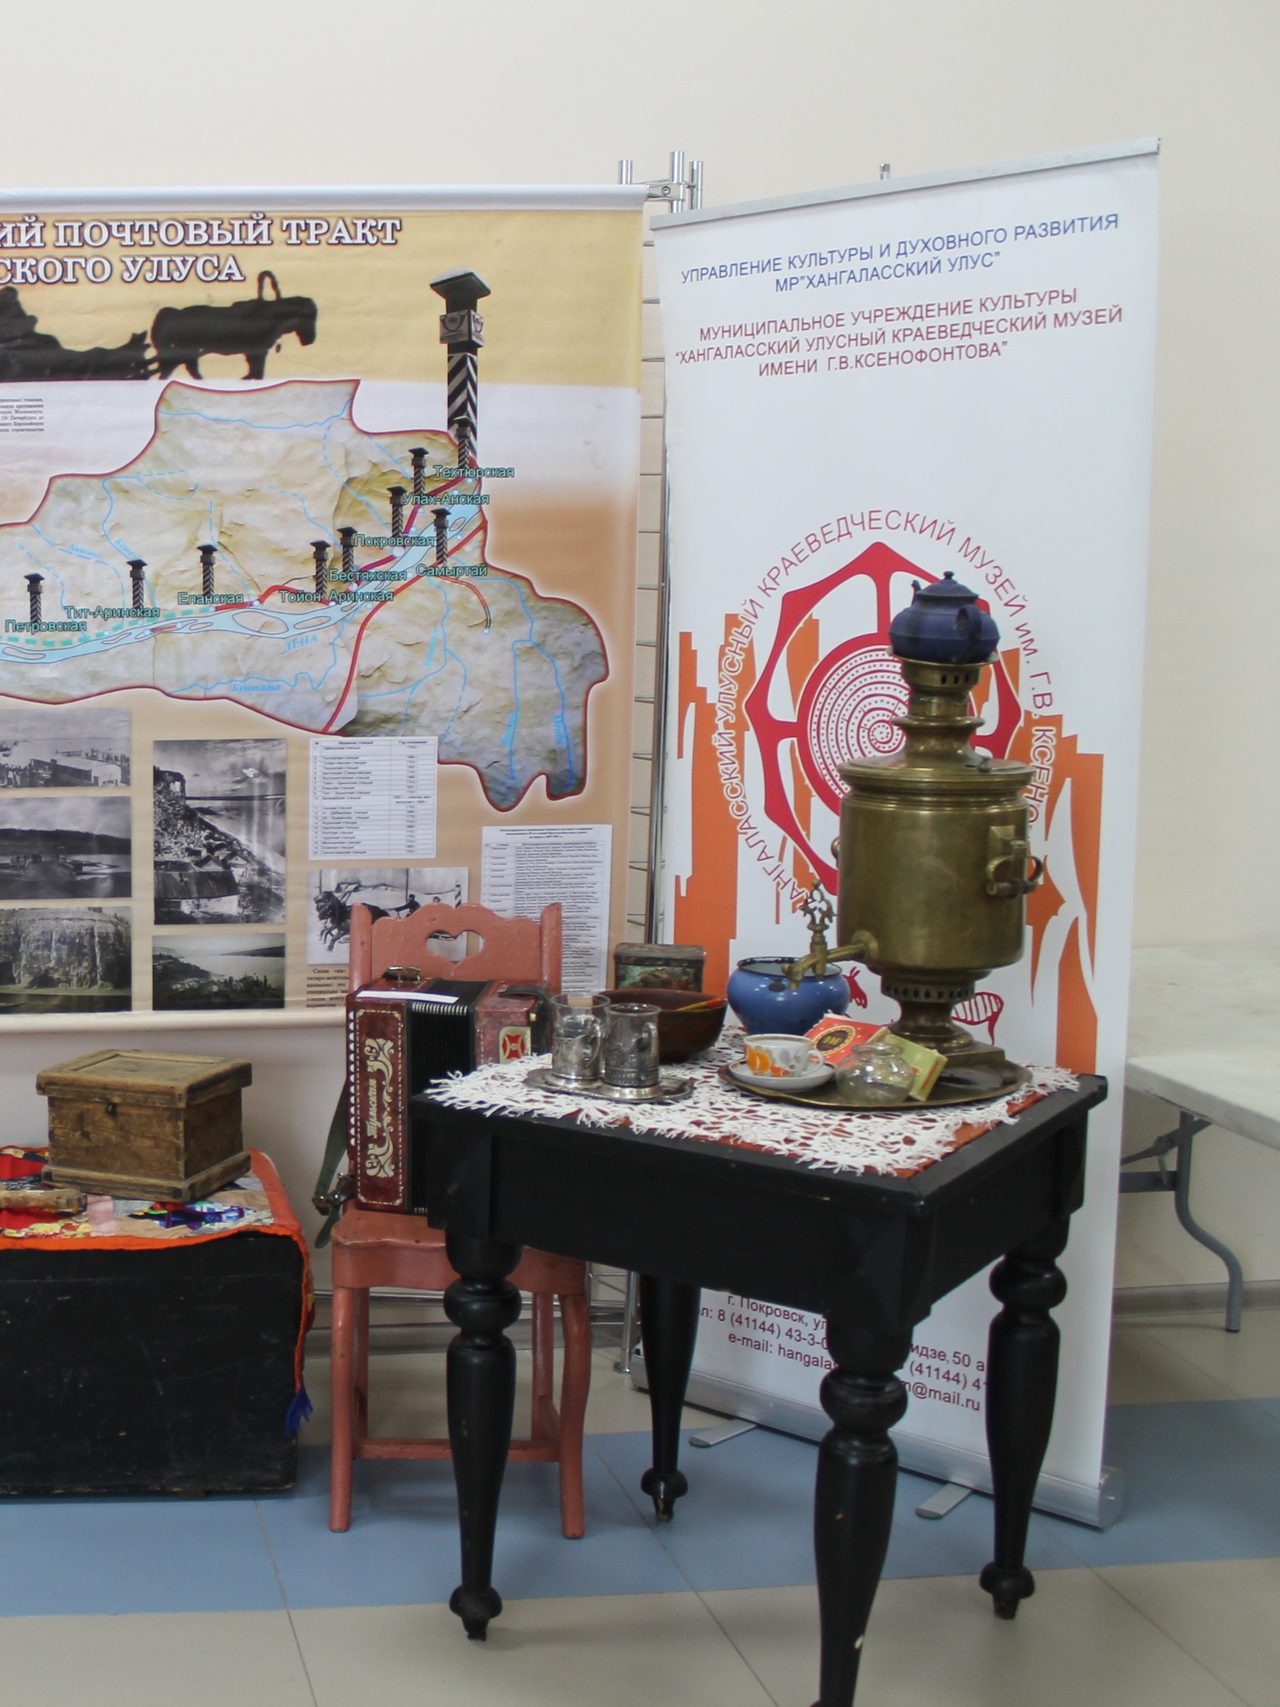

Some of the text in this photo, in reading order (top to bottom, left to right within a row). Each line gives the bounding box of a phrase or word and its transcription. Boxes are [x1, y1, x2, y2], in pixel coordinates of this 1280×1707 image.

[54, 212, 273, 247] ПОЧТОВЫЙ
[281, 218, 402, 246] ТРАКТ
[681, 213, 1119, 284] УПРАВЛЕНИЕ КУЛЬТУРЫ И ДУХОВНОГО РАЗВИТИЯ
[120, 255, 246, 283] УЛУСА
[699, 288, 1077, 342] МУНИЦИПАЛЬНОЕ УЧРЕЖДЕНИЕ КУЛЬТУРЫ
[805, 327, 886, 353] УЛУСНЫЙ
[892, 311, 1047, 344] КРАЕВЕДЧЕСКИЙ
[1053, 304, 1122, 329] МУЗЕЙ
[758, 359, 818, 377] ИМЕНИ
[434, 465, 515, 479] Техтюрская
[402, 493, 490, 505] Улах-Анская
[354, 534, 436, 547] Покровская
[757, 509, 957, 598] КРАЕВЕДЧЕСКИЙ
[329, 570, 407, 582] Бестяхская
[416, 565, 488, 578] Самыртай
[958, 537, 1028, 618] МУЗЕЙ
[178, 592, 244, 605] Еланская
[279, 590, 394, 602] Тойон Аринская
[5, 619, 87, 633] Петровская
[65, 605, 160, 619] Тит-Аринская
[1015, 622, 1039, 665] им.
[715, 597, 765, 722] УЛУСНЫЙ
[713, 730, 812, 902] АНГАЛАССКИЙ
[717, 1309, 726, 1322] 8
[730, 1312, 781, 1340] (41144)
[740, 1296, 808, 1328] Покровск,
[728, 1331, 773, 1355] e-mail:
[952, 1350, 970, 1367] 50
[910, 1361, 968, 1391] (41144)
